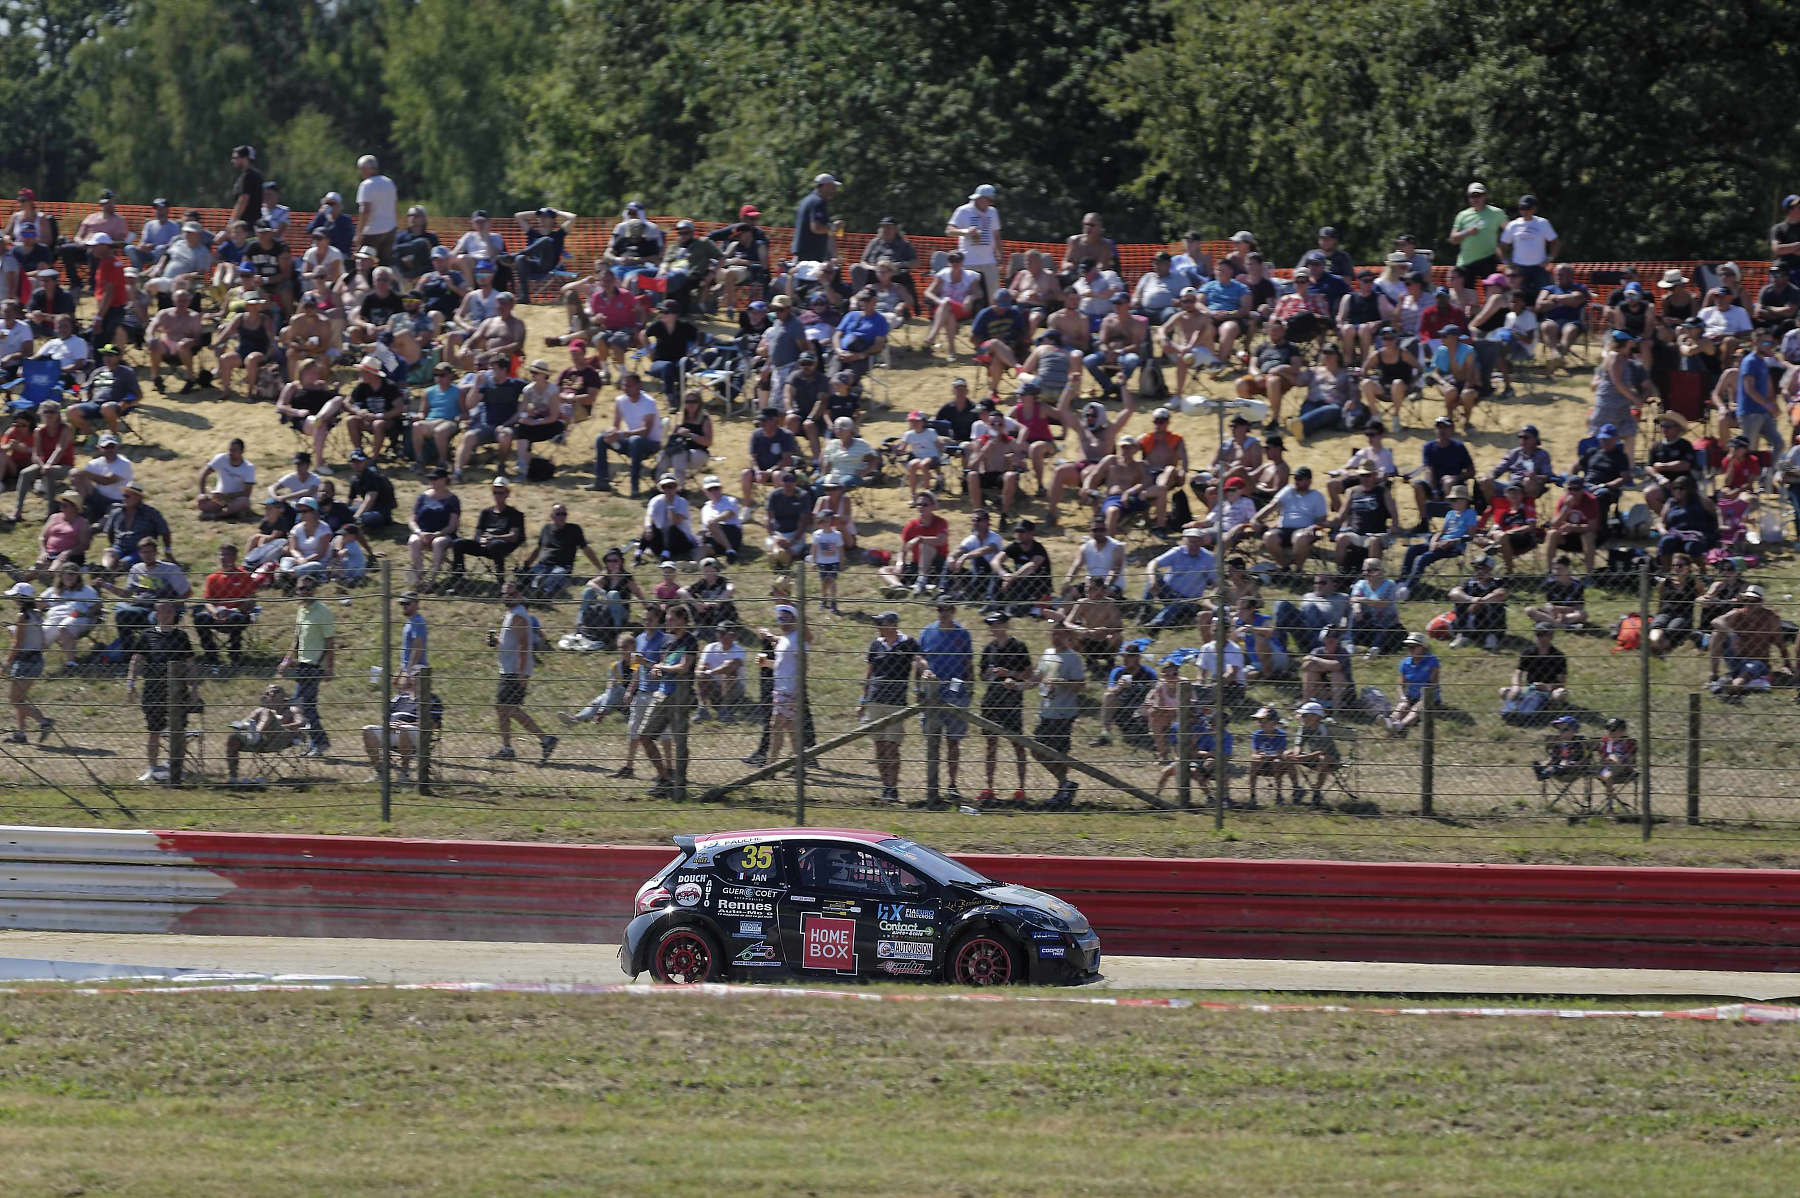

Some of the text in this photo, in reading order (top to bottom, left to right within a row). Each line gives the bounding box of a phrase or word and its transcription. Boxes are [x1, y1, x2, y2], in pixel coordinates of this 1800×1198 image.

[741, 845, 773, 869] 35
[752, 874, 767, 882] JAN
[704, 880, 712, 907] AUTO
[718, 899, 773, 911] Rennes
[879, 920, 919, 931] Contact
[810, 928, 850, 944] HOME
[810, 944, 849, 959] BOX
[896, 943, 932, 955] AUTOVISION
